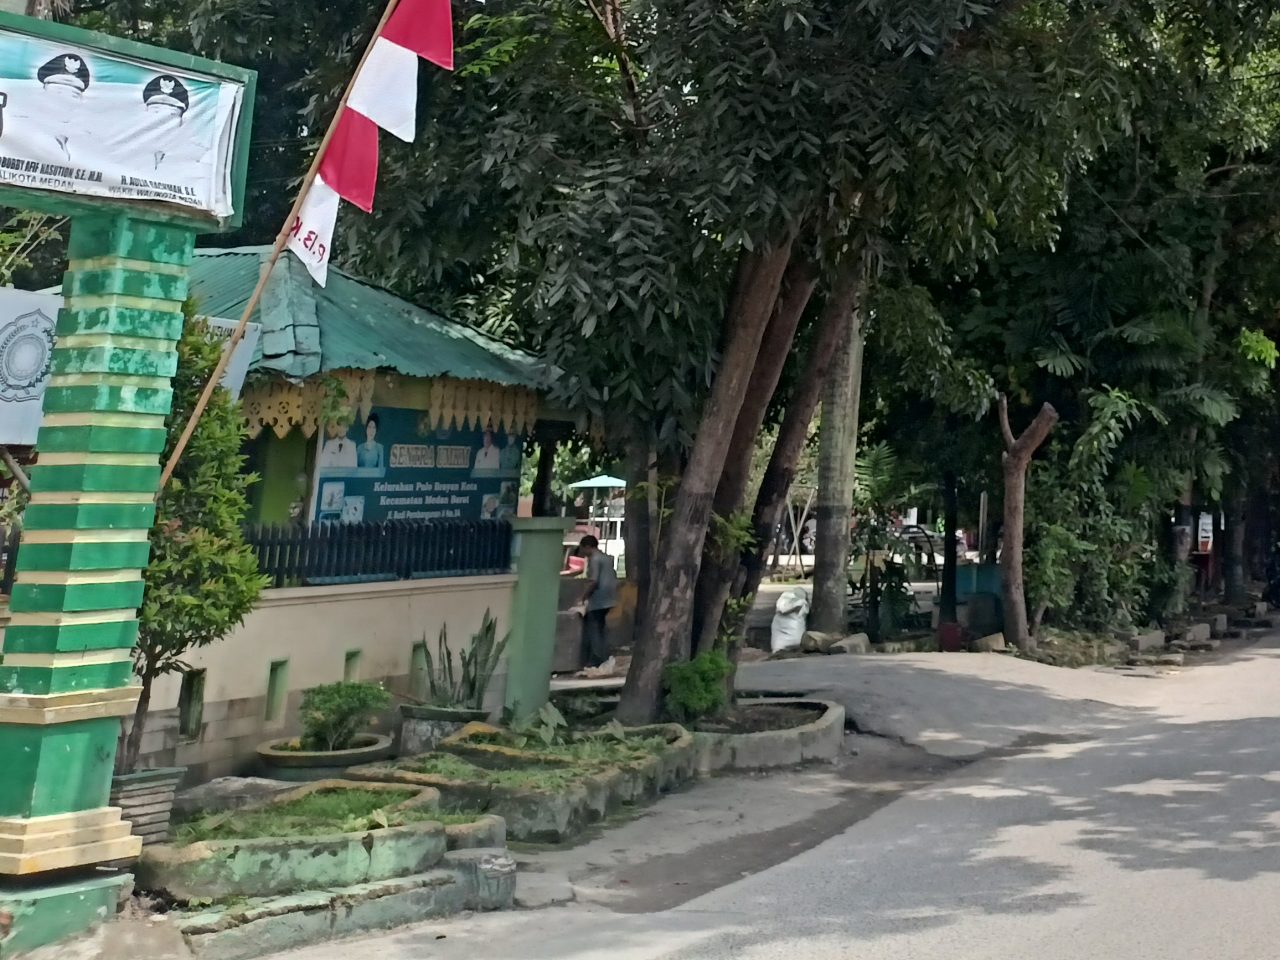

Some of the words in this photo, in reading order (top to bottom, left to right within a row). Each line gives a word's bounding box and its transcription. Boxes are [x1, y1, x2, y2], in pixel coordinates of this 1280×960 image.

[40, 162, 74, 178] NASUTION
[40, 177, 74, 189] MEDAN
[373, 482, 414, 492] Kelurahan
[416, 482, 433, 491] Pulo
[460, 481, 478, 491] Kota
[380, 495, 423, 505] Kecamatan
[425, 495, 449, 504] Medan
